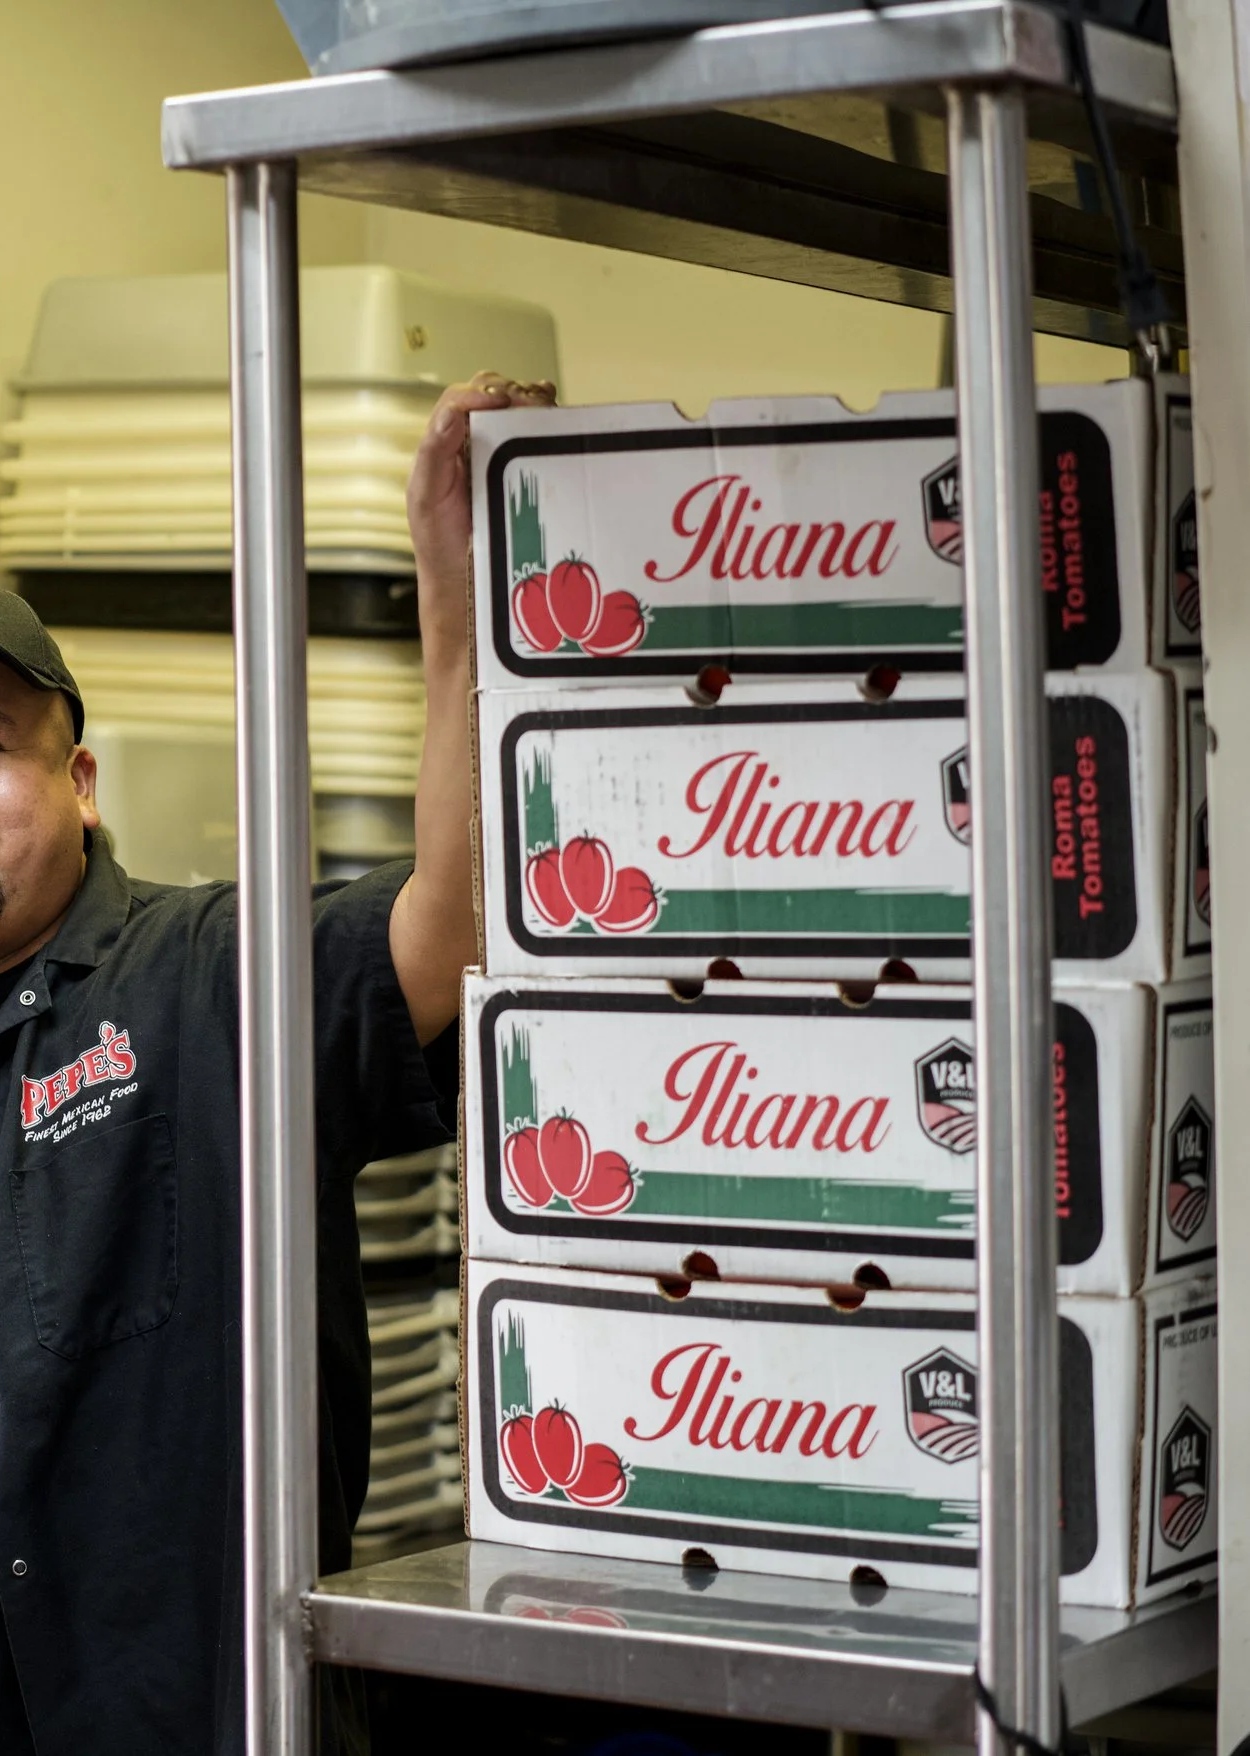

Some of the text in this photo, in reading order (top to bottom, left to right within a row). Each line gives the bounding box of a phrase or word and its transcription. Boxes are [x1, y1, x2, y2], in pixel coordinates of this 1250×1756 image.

[643, 474, 899, 584] Iliana
[1057, 451, 1086, 631] Tomatoes
[658, 751, 917, 860] Iliana
[1052, 775, 1077, 880] Roma
[1076, 735, 1104, 920] Tomatoes
[21, 1020, 137, 1129] PEPE'S
[24, 1082, 138, 1142] FINEST MEXICAN FOOD
[635, 1041, 892, 1153] Iliana
[53, 1120, 78, 1143] SINCE
[1176, 1126, 1204, 1161] V&L
[623, 1342, 879, 1460] Iliana
[919, 1370, 972, 1401] V&L
[1170, 1434, 1200, 1473] V&L
